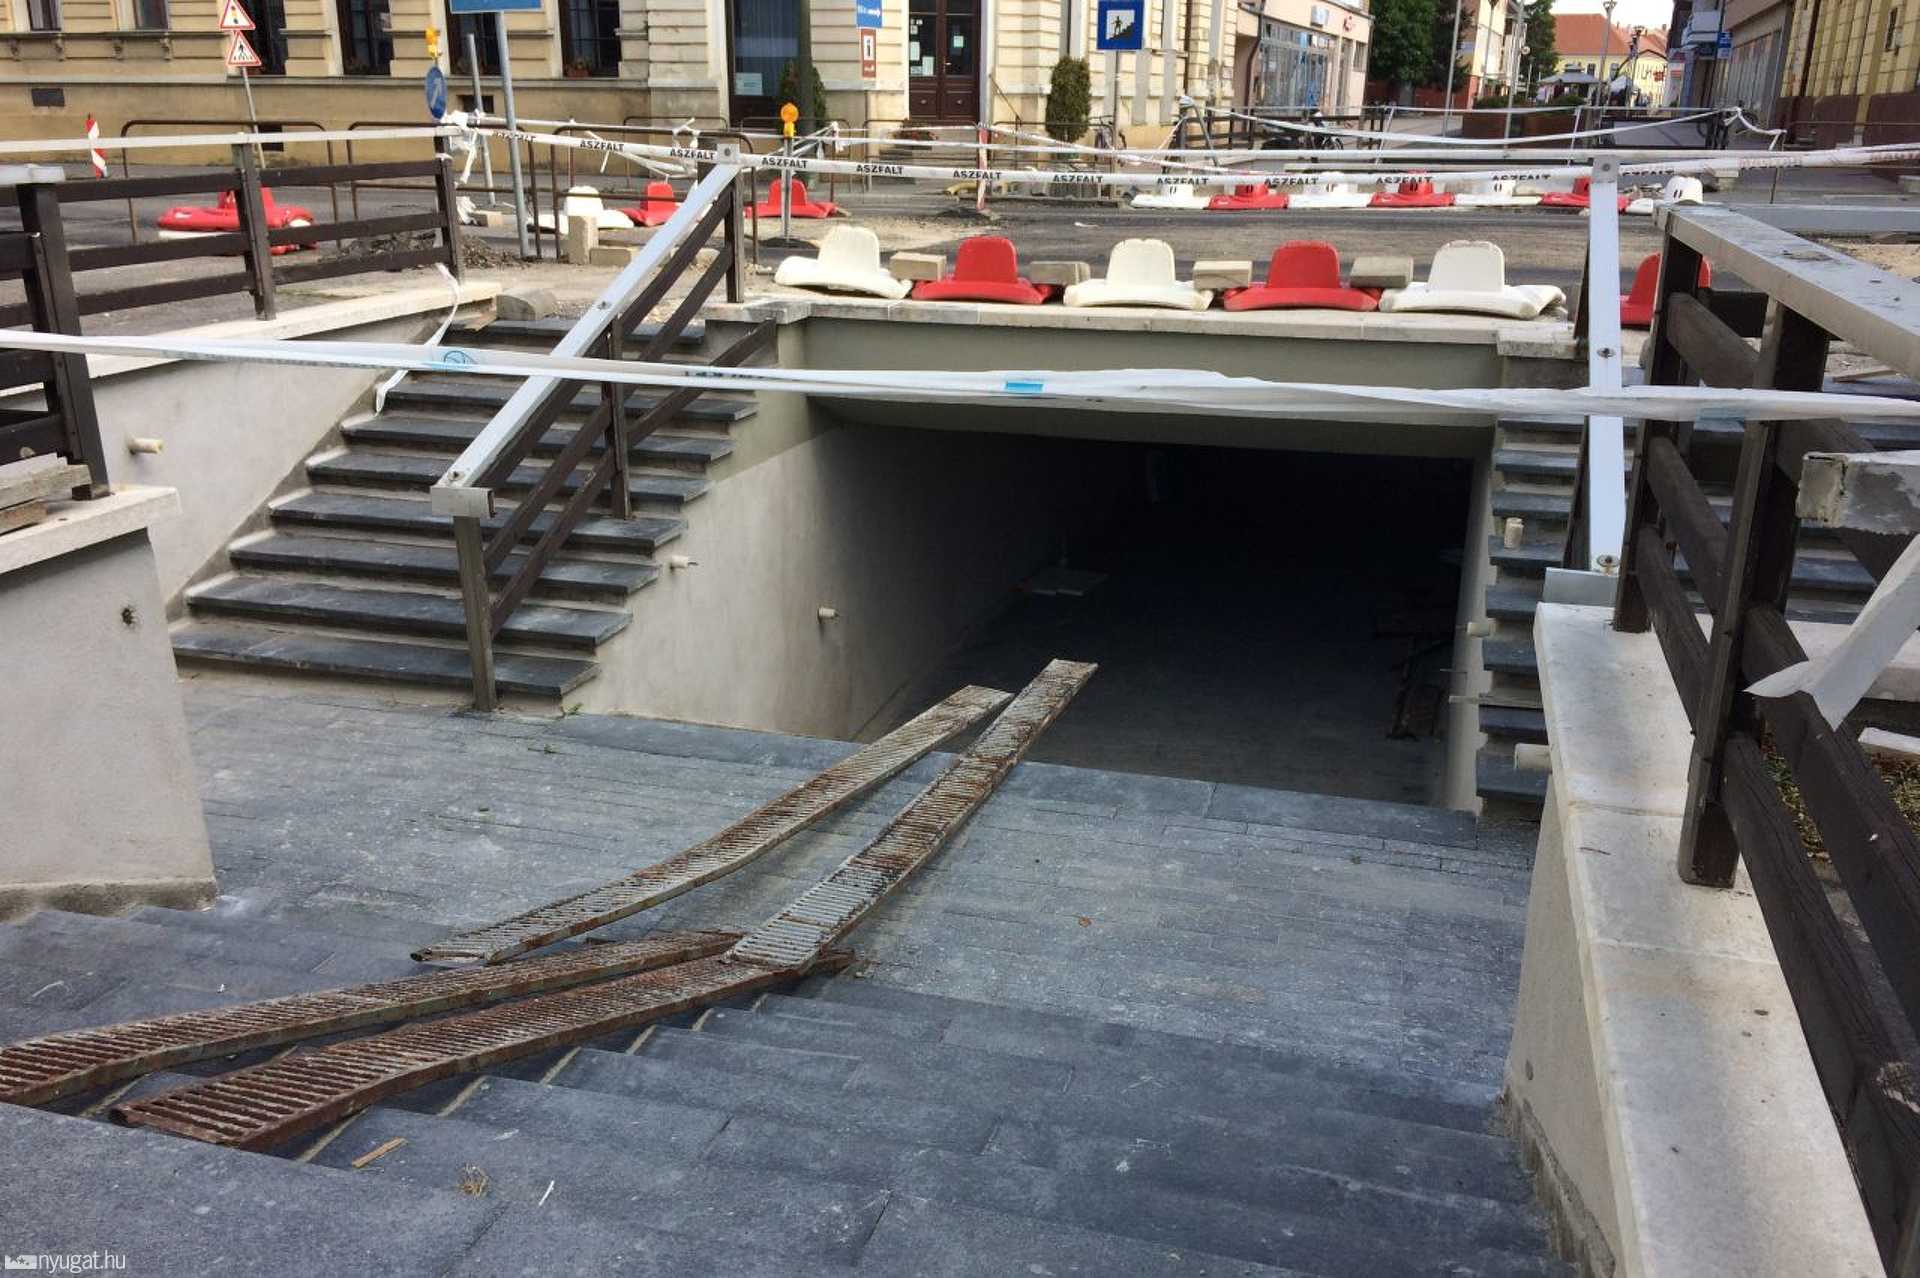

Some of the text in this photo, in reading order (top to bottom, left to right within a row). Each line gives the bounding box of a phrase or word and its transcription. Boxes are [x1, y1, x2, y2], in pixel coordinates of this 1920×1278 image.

[670, 149, 715, 161] ASZFALT
[761, 158, 808, 170] ASZFALT
[856, 165, 904, 175] ASZFALT
[953, 170, 1001, 181] ASZFALT
